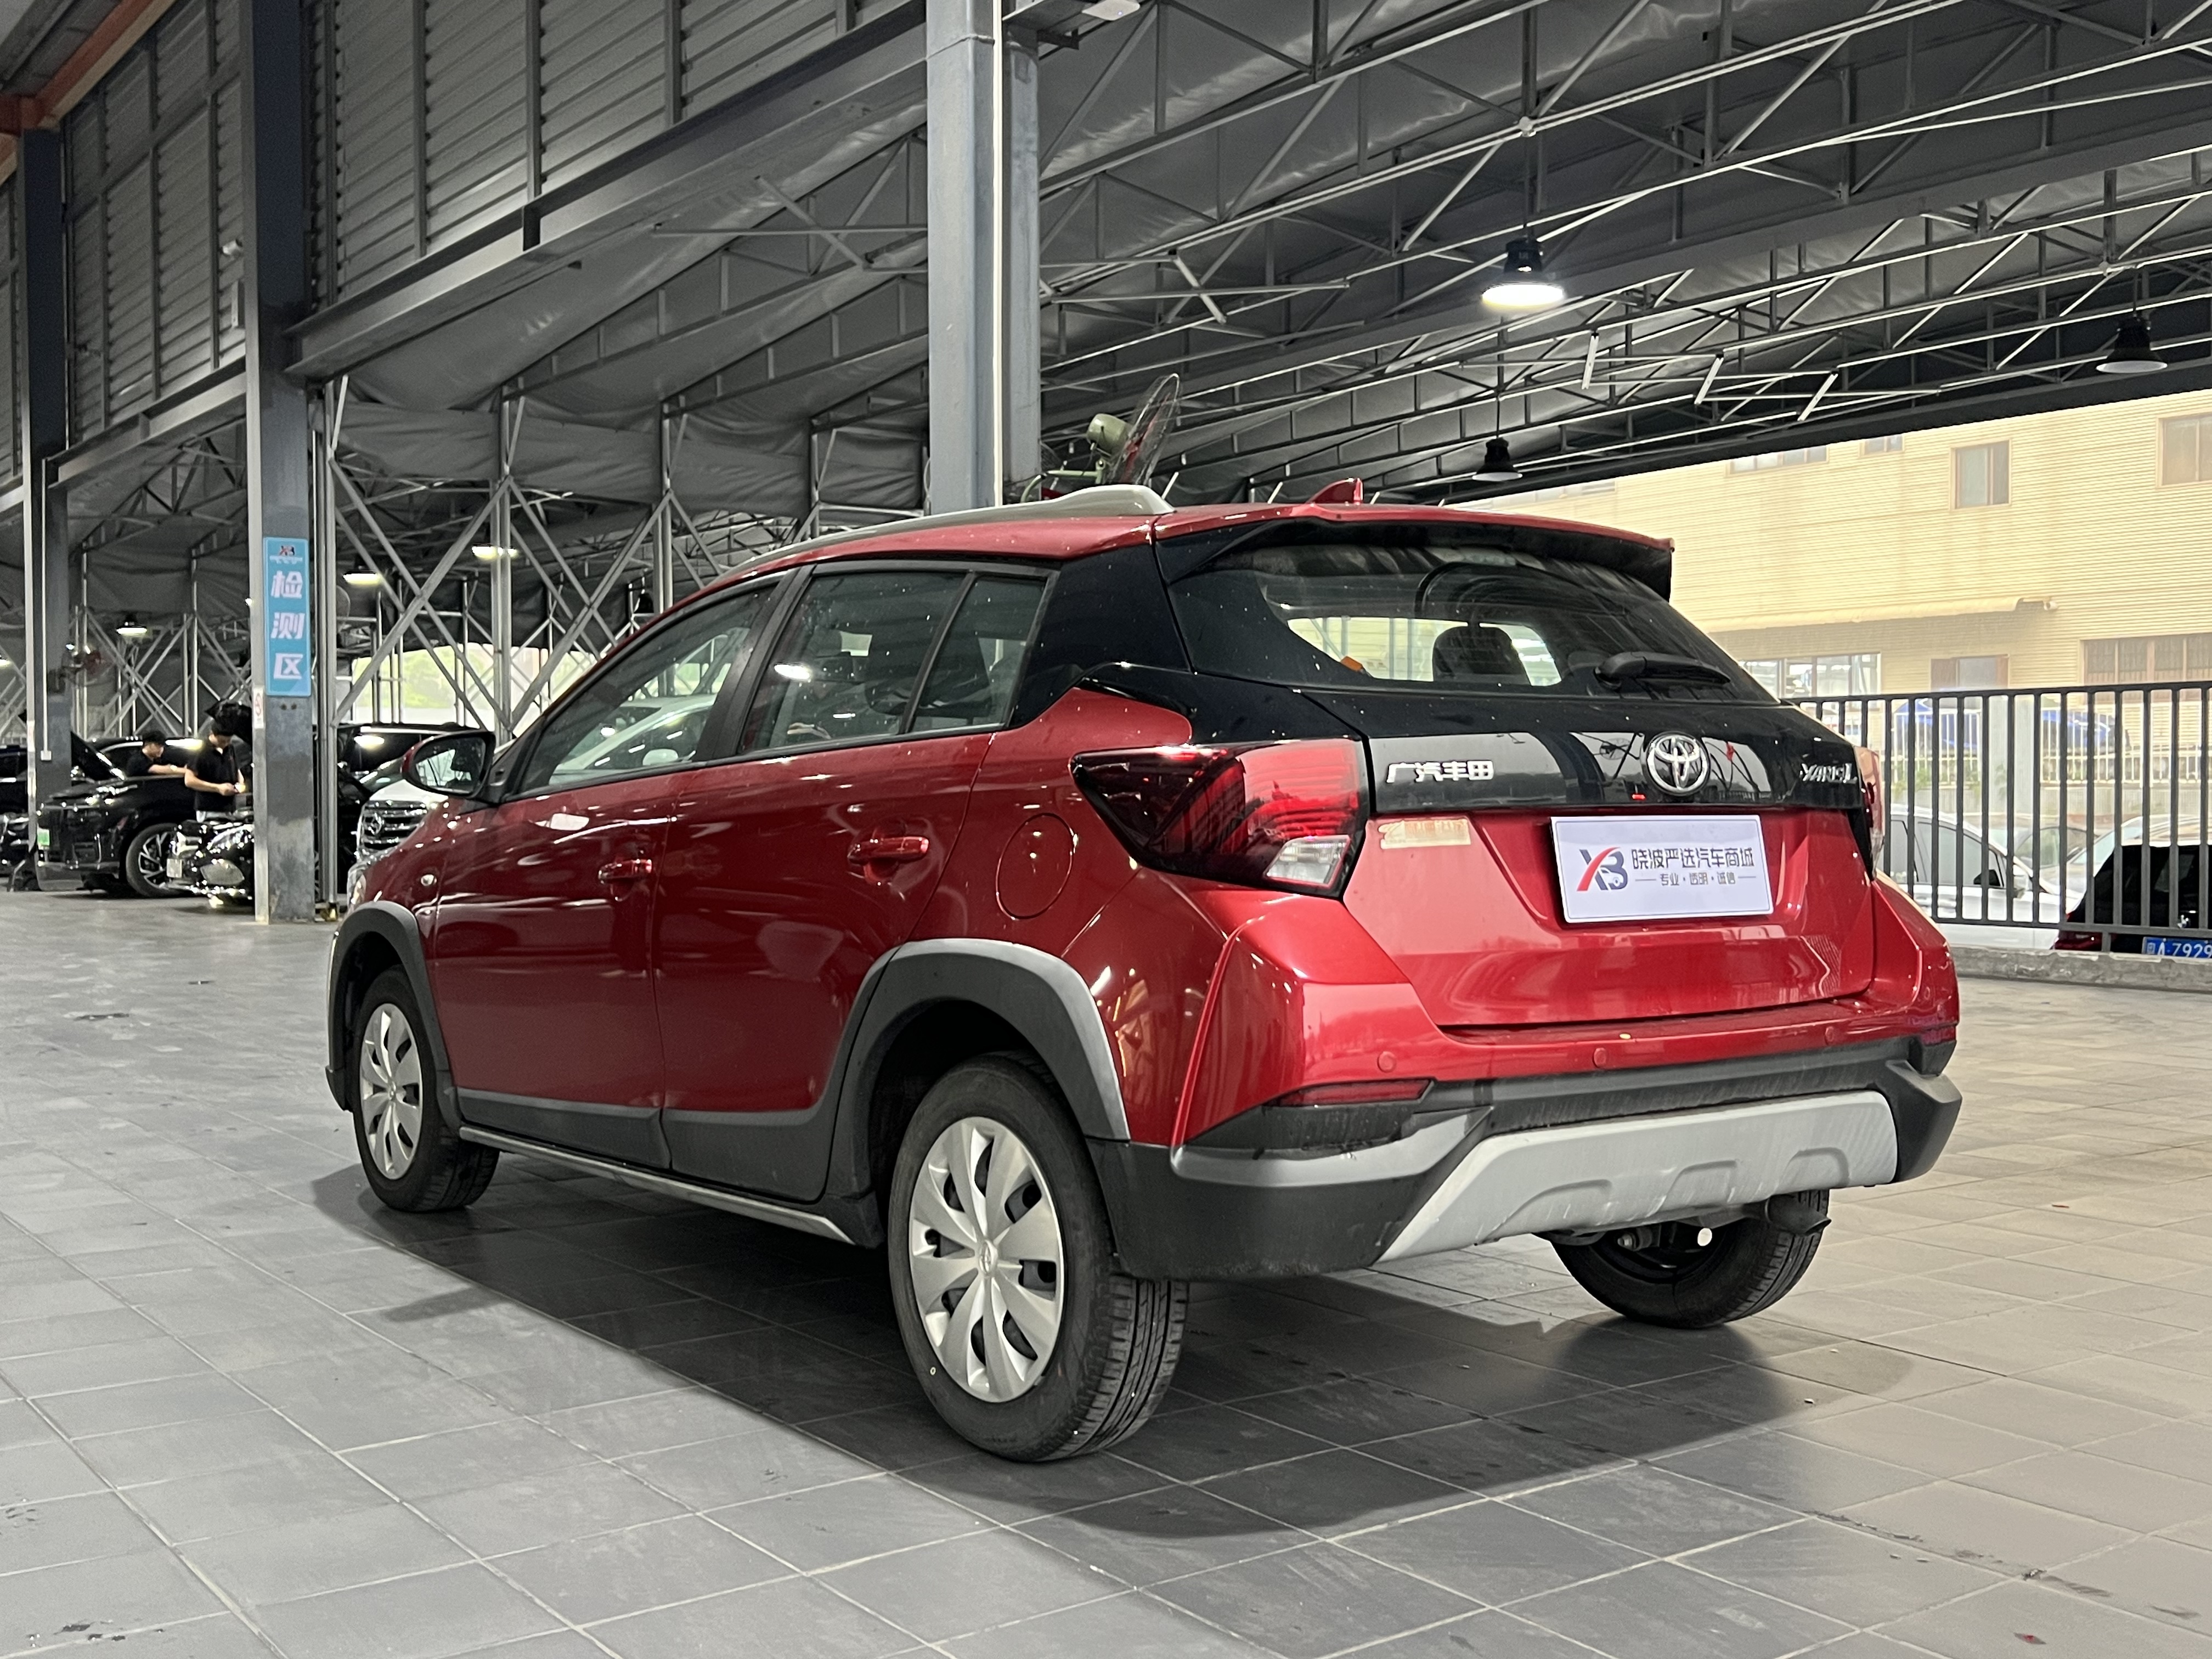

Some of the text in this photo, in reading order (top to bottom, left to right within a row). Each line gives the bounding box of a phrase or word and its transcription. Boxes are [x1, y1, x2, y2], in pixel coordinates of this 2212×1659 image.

[270, 570, 306, 680] 检测区
[1386, 760, 1494, 783] 广汽丰田
[1631, 847, 1754, 870] 晓波严选汽车商城
